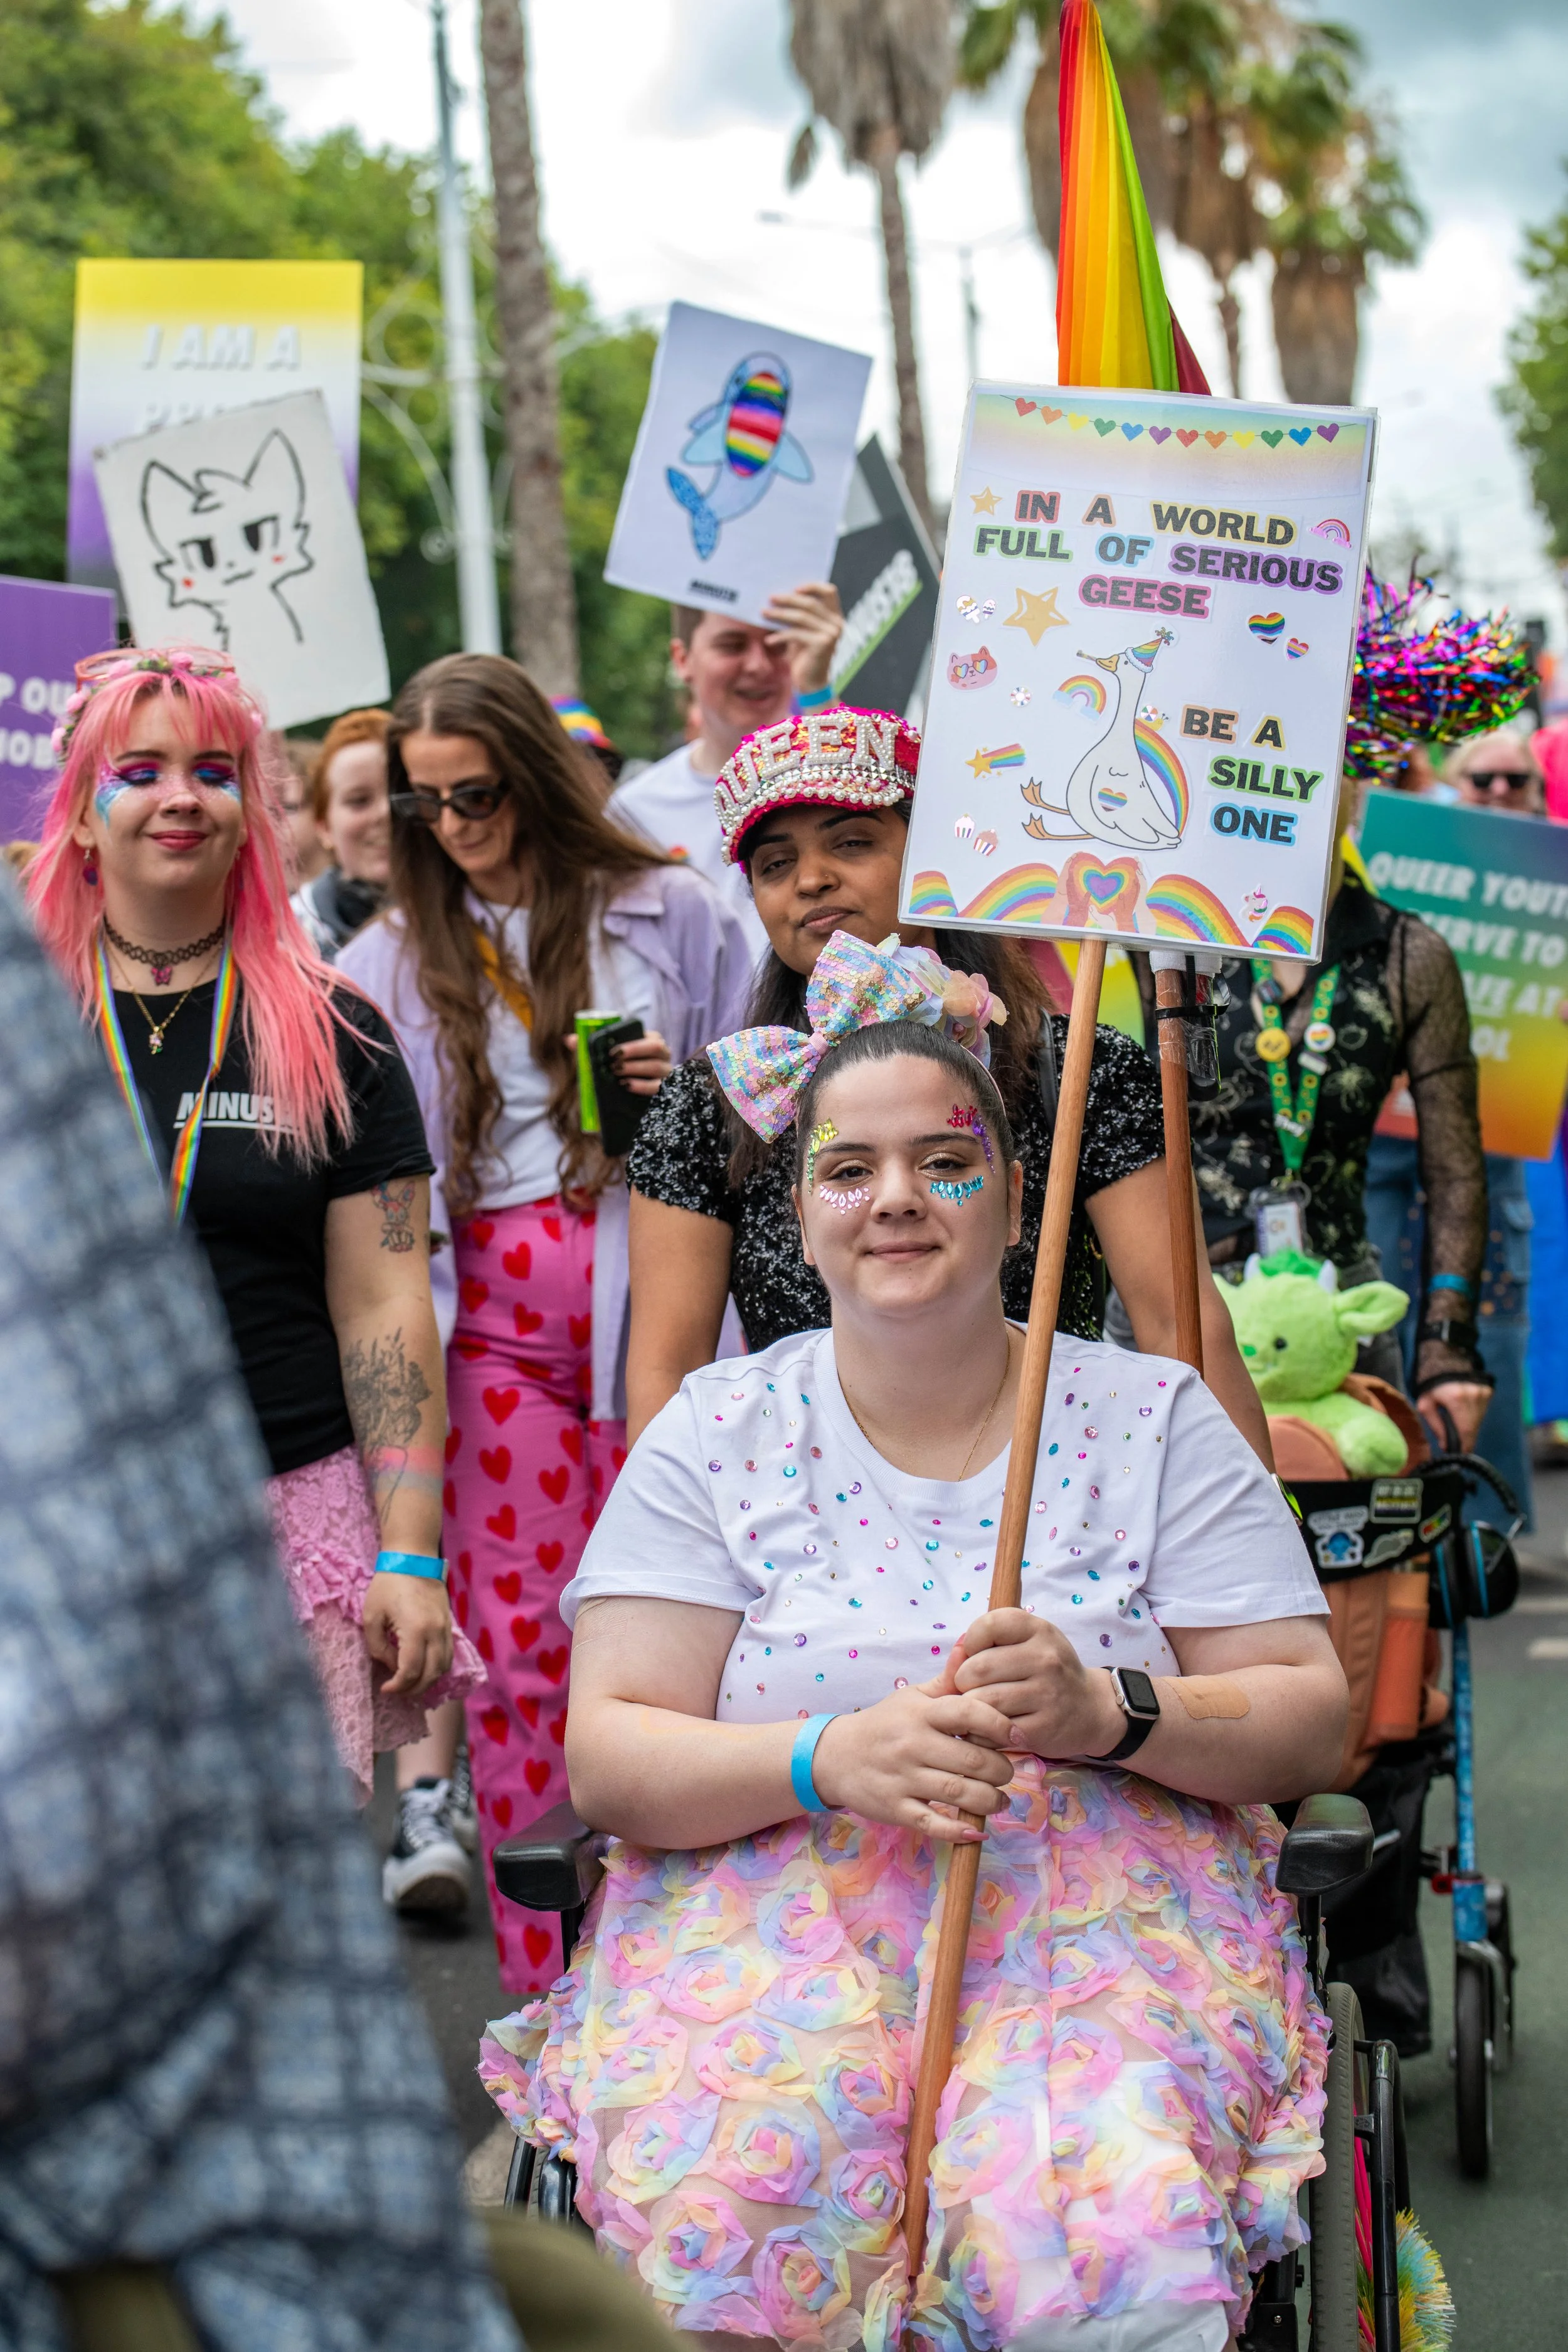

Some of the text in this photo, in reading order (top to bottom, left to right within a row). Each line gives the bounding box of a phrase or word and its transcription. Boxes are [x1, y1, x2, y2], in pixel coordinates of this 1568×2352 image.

[142, 324, 302, 370] I AM A
[1017, 492, 1295, 546] IN A WORLD
[975, 527, 1342, 593] FULL OF SERIOUS
[1081, 577, 1209, 616] GEESE
[1182, 707, 1283, 749] BE A
[1210, 758, 1321, 801] SILLY
[1213, 806, 1296, 844] ONE
[1368, 850, 1568, 920] QUEER YOUT
[1520, 930, 1567, 969] TO
